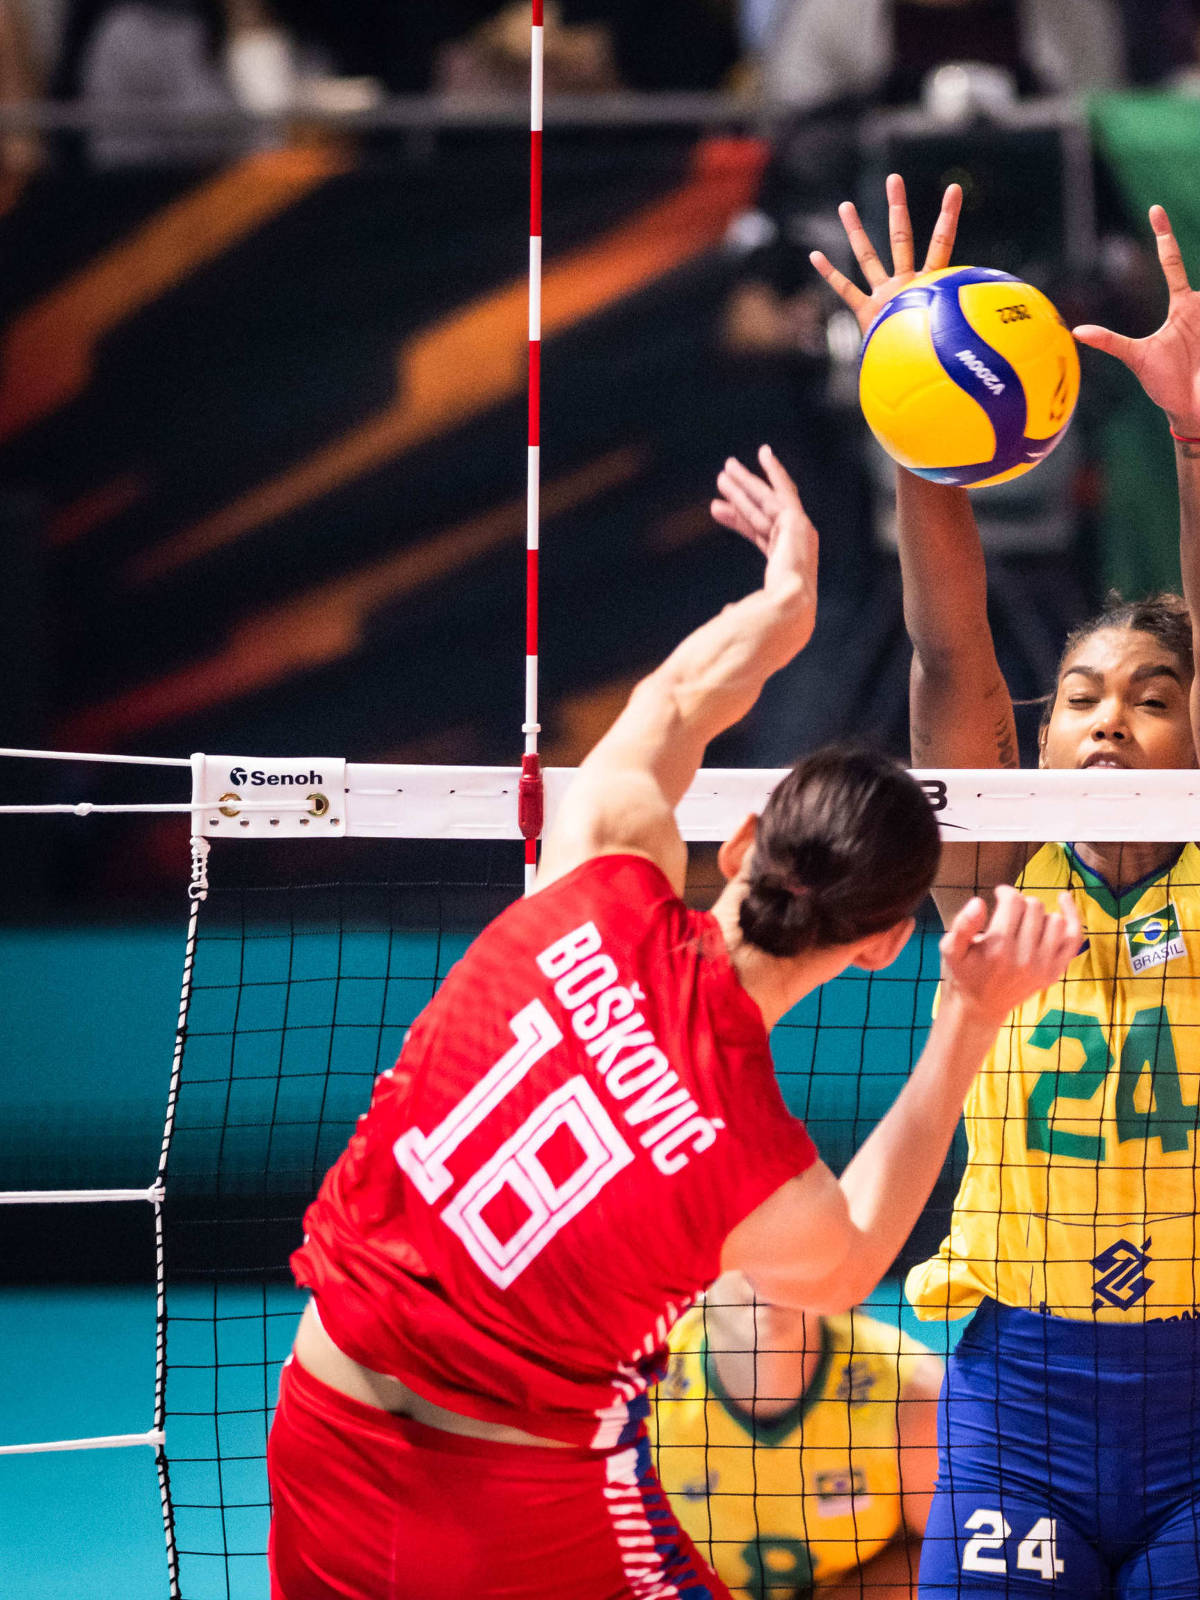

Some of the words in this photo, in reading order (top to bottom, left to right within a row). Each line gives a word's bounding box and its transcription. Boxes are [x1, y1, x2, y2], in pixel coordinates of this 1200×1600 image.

[955, 349, 1006, 396] V200W
[251, 770, 323, 786] Senoh
[1132, 943, 1185, 971] BRASIL
[535, 920, 726, 1176] BOŠKOVIĆ
[392, 997, 636, 1291] 18
[962, 1508, 1065, 1580] 24
